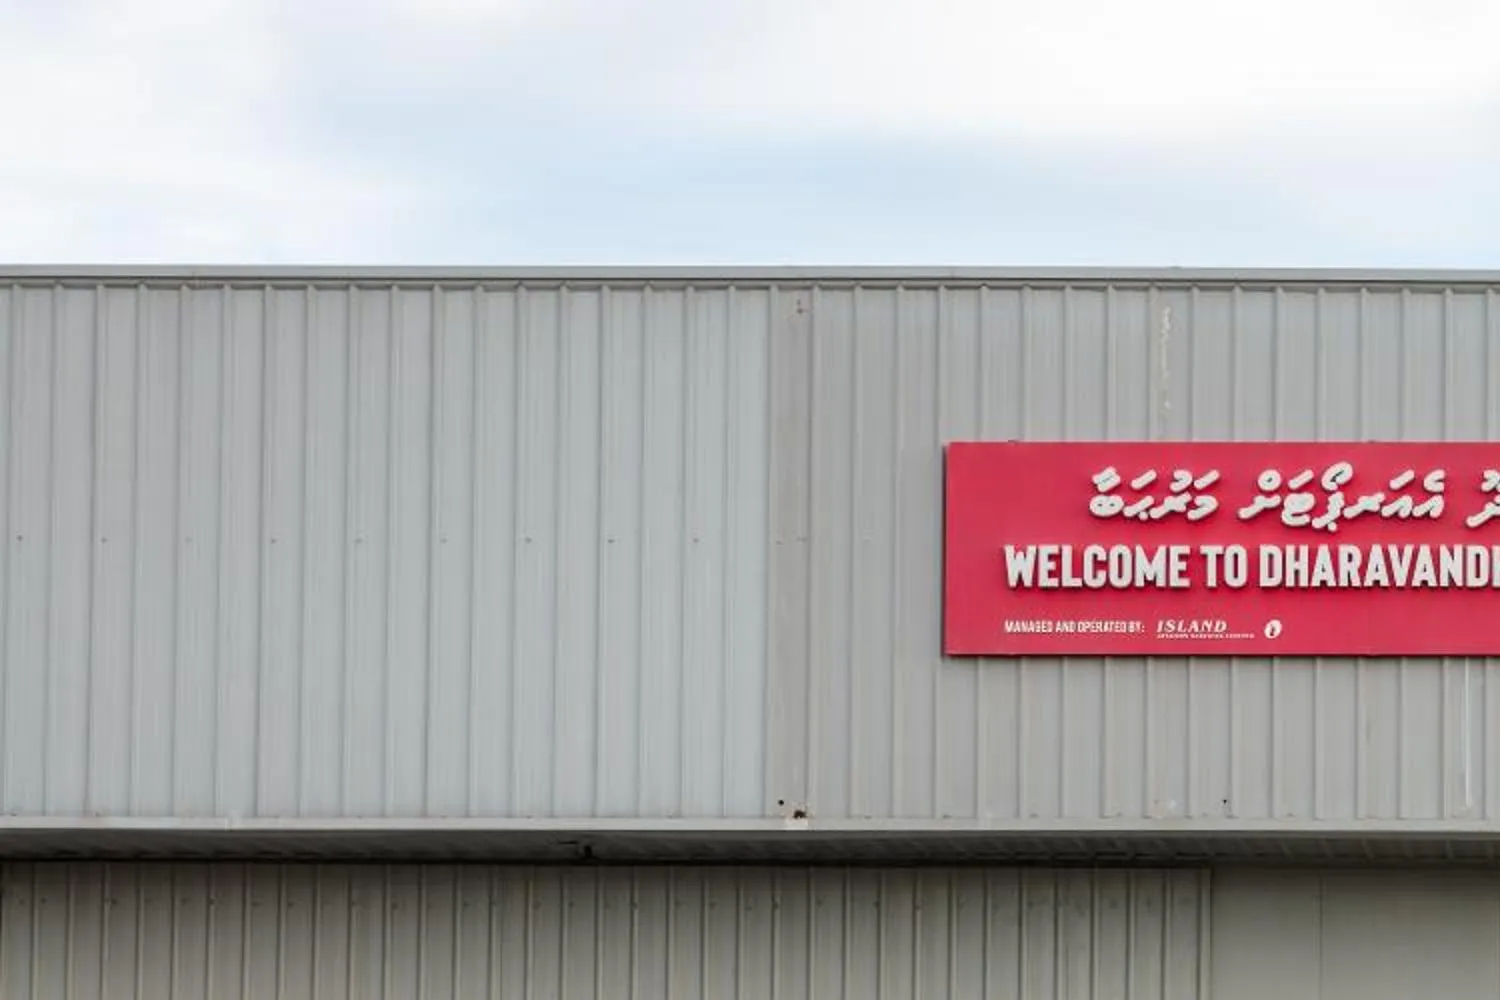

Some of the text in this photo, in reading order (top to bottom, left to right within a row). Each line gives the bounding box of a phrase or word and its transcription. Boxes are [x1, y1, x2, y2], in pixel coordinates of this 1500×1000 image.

[1003, 543, 1191, 588] WELCOME
[1200, 543, 1249, 588] TO
[1004, 619, 1145, 633] MANAGED AND OPERATED BY:
[1156, 619, 1228, 633] ISLAND
